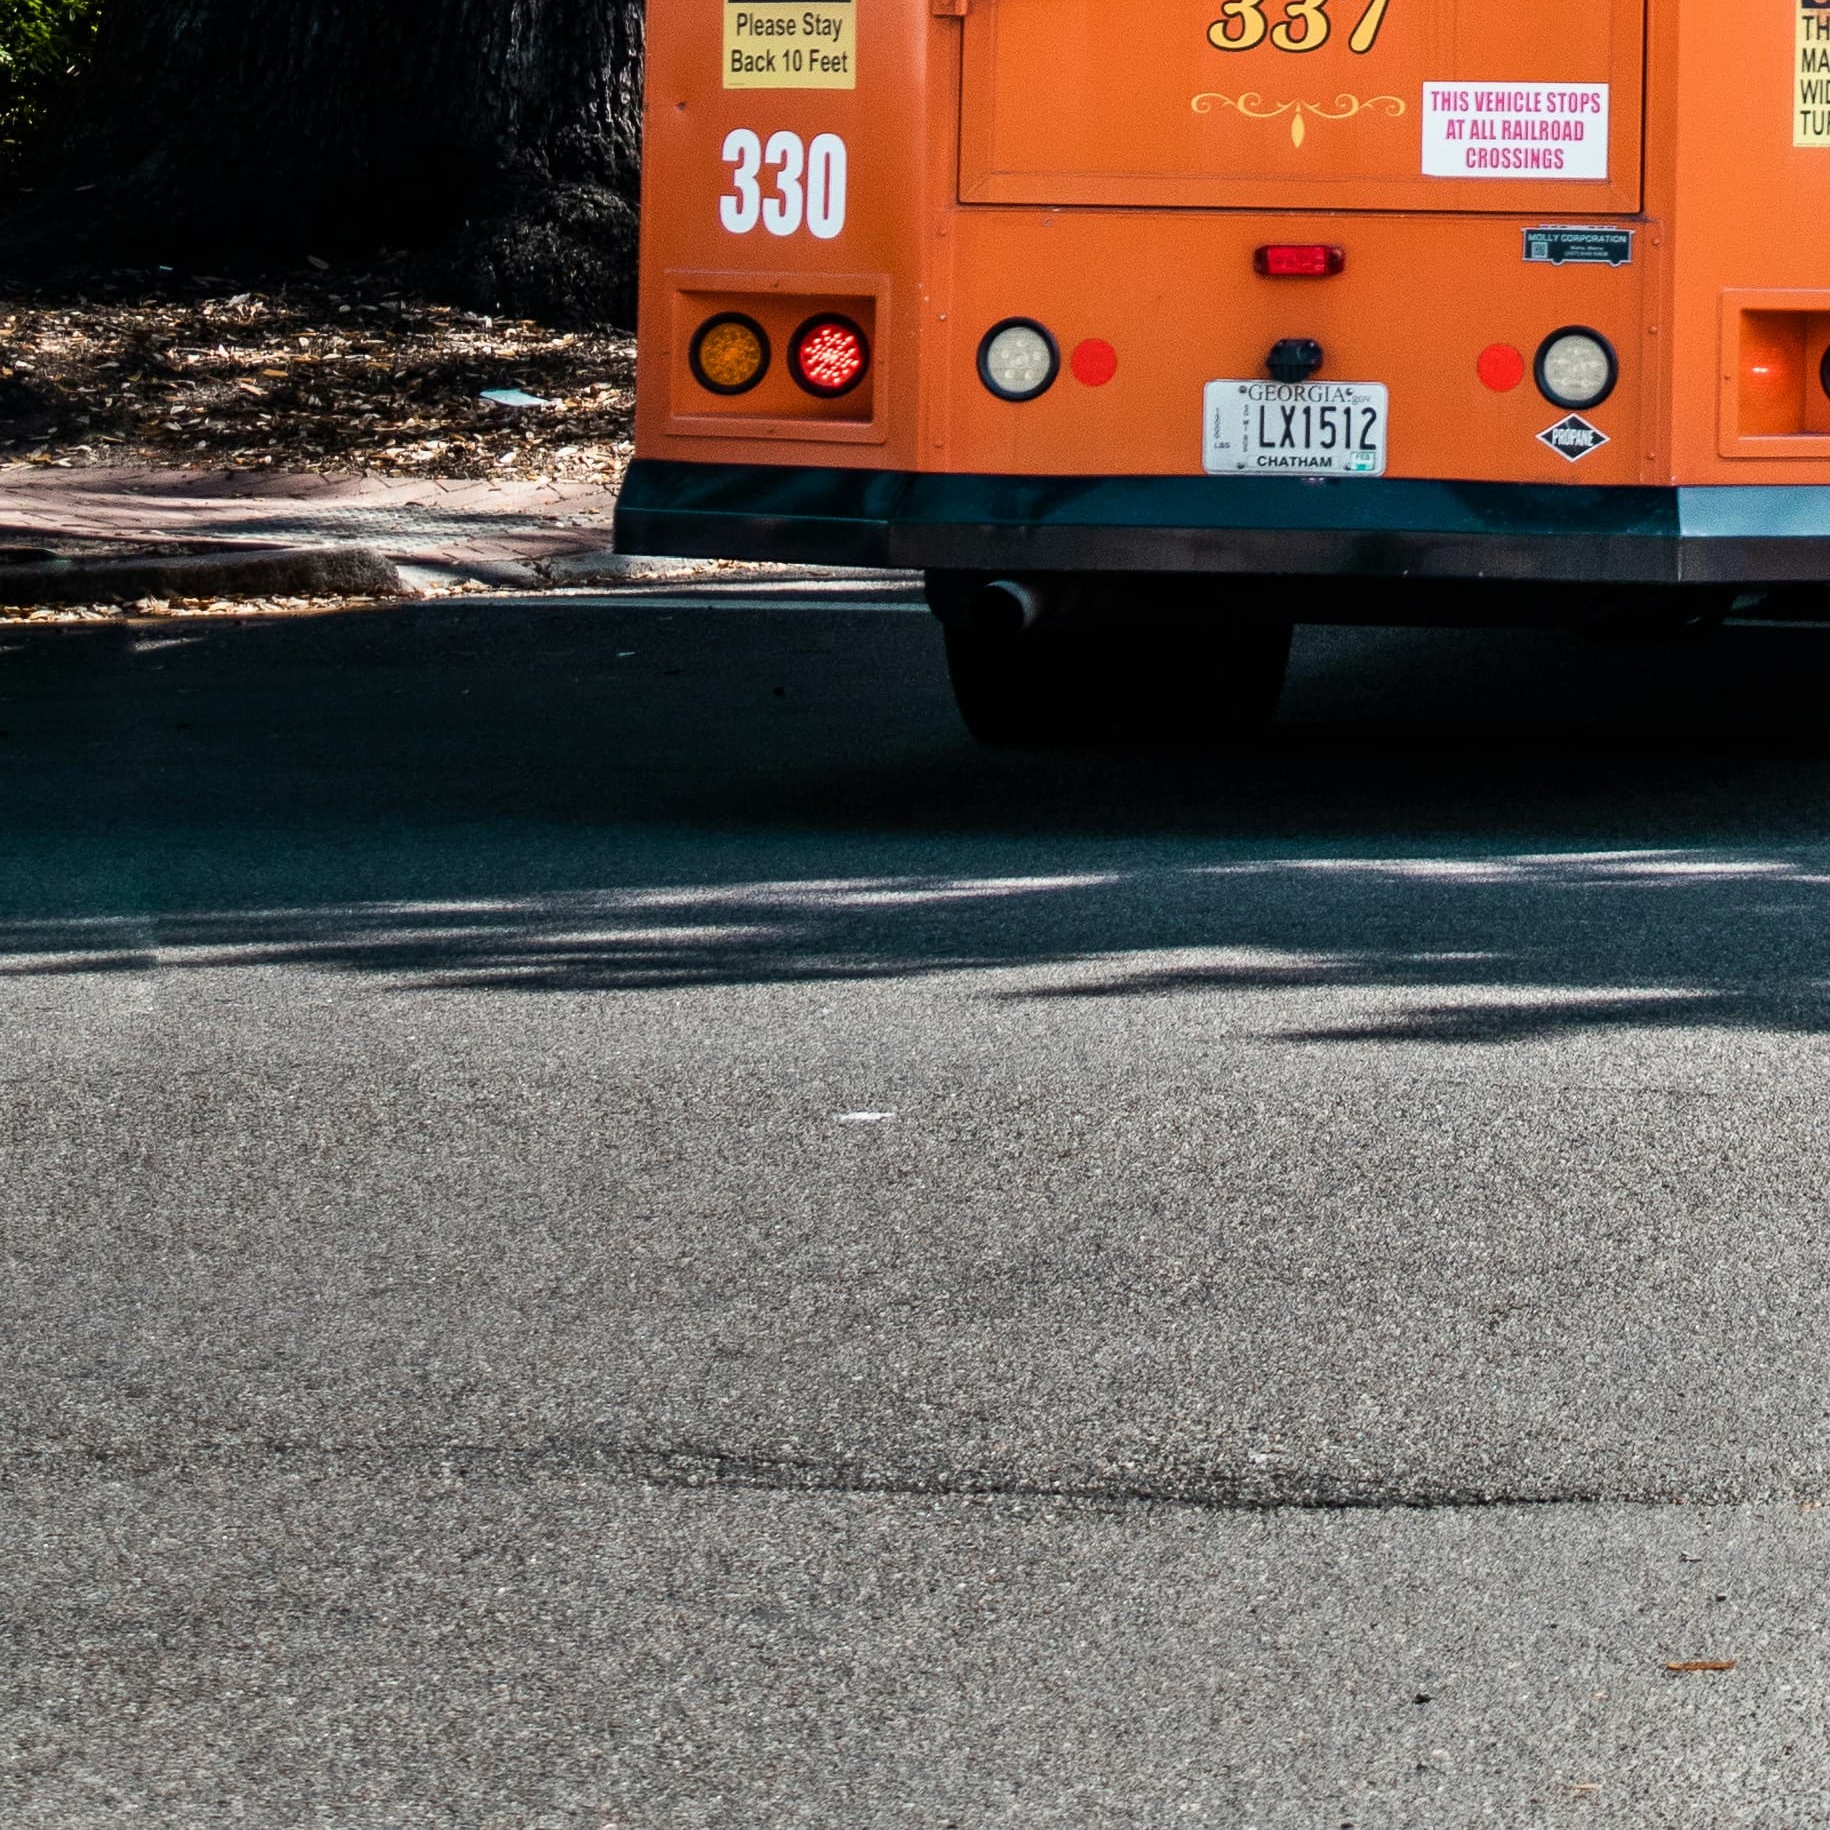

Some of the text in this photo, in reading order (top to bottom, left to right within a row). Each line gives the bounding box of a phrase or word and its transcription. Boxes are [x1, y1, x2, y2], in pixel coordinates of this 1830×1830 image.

[736, 12, 843, 43] Please Stay
[731, 48, 848, 73] Back 10 Feet
[1431, 90, 1601, 114] THIS VEHICLE STOPS
[1446, 119, 1585, 141] AT ALL RAILROAD
[1465, 147, 1564, 170] CROSSINGS
[718, 127, 848, 239] 330
[1527, 233, 1627, 244] MOLLY CORPORATION
[1258, 404, 1378, 451] LX1512
[1551, 428, 1595, 447] PROPANE
[1256, 455, 1333, 468] CHATHAM
